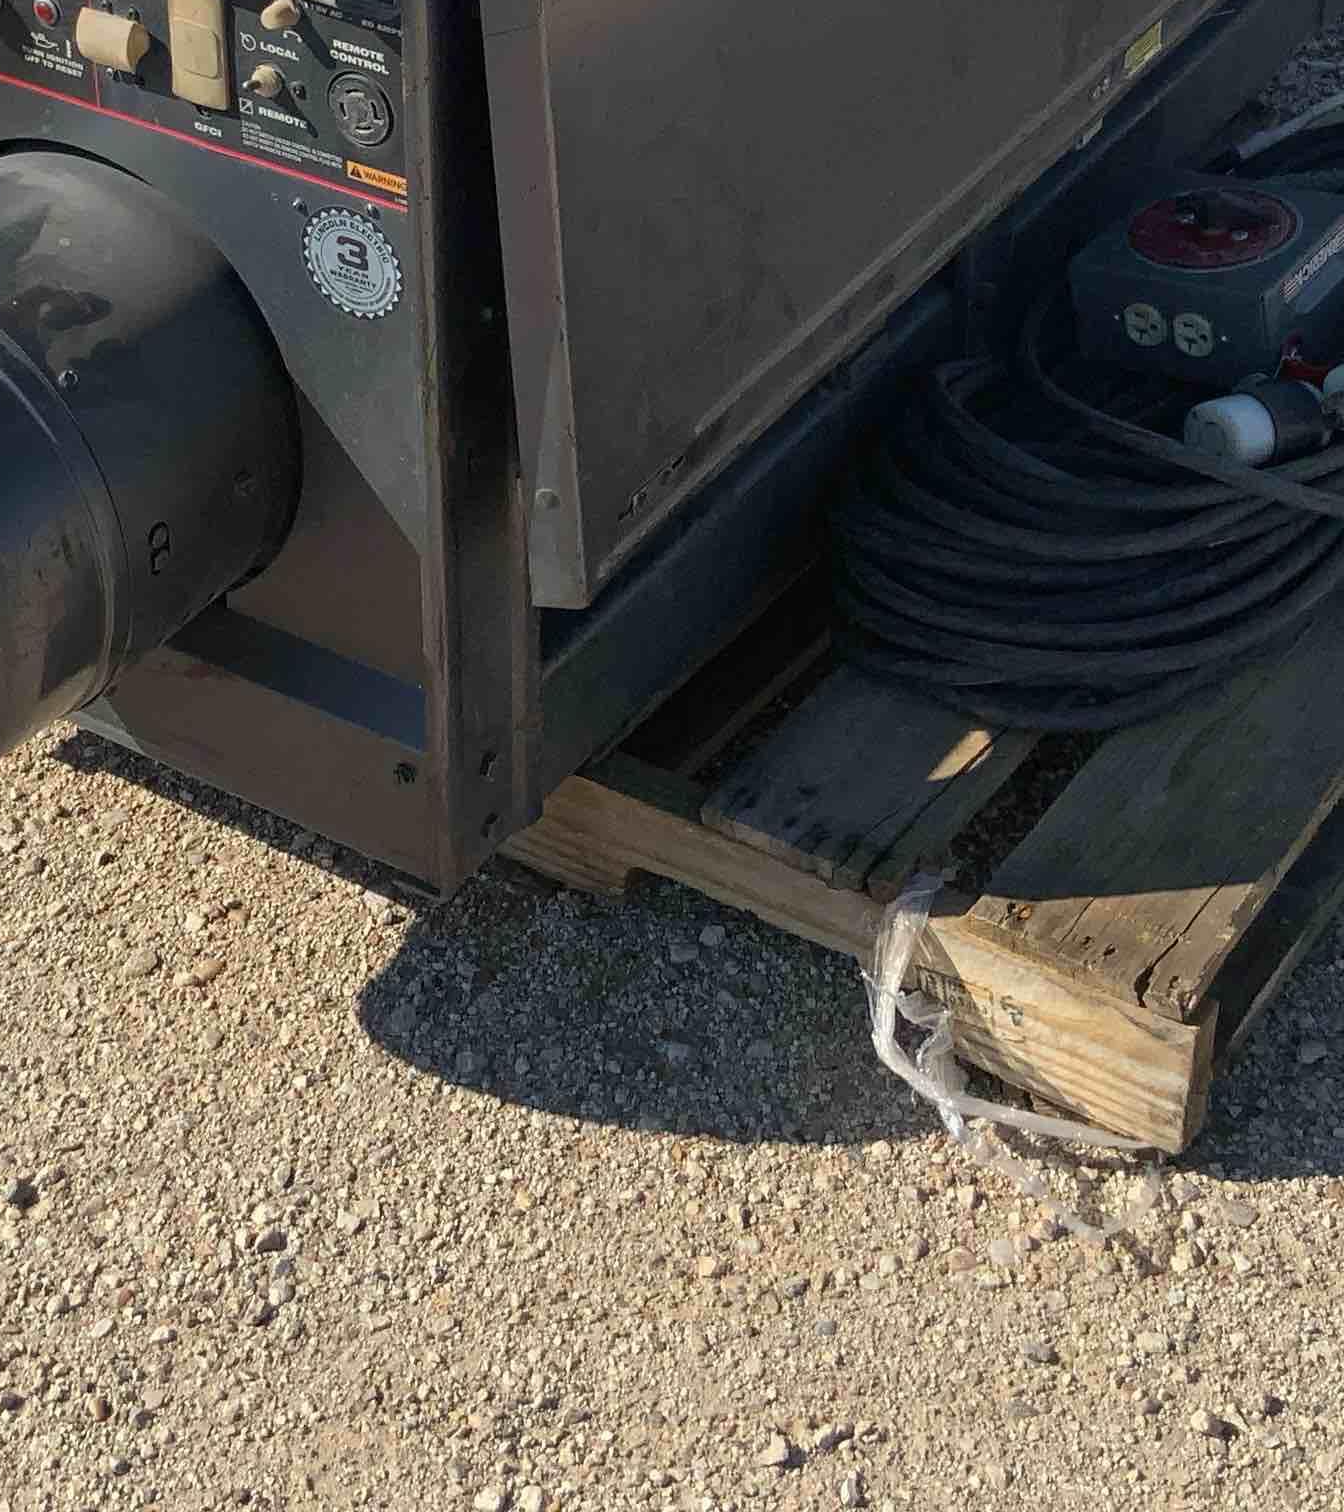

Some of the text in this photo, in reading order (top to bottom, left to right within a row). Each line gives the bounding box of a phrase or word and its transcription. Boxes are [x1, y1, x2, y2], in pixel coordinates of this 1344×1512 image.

[45, 50, 85, 71] IGNITION
[259, 41, 300, 61] LOCAL
[332, 39, 385, 63] REMOTE
[42, 59, 54, 69] TO
[55, 64, 83, 78] RESET
[330, 50, 390, 76] CONTROL
[194, 121, 223, 138] GFCI
[313, 218, 390, 265] LINCOLN ELECTRIC
[336, 235, 369, 271] 3
[329, 269, 377, 289] WARRANTY
[337, 264, 369, 280] YEAR
